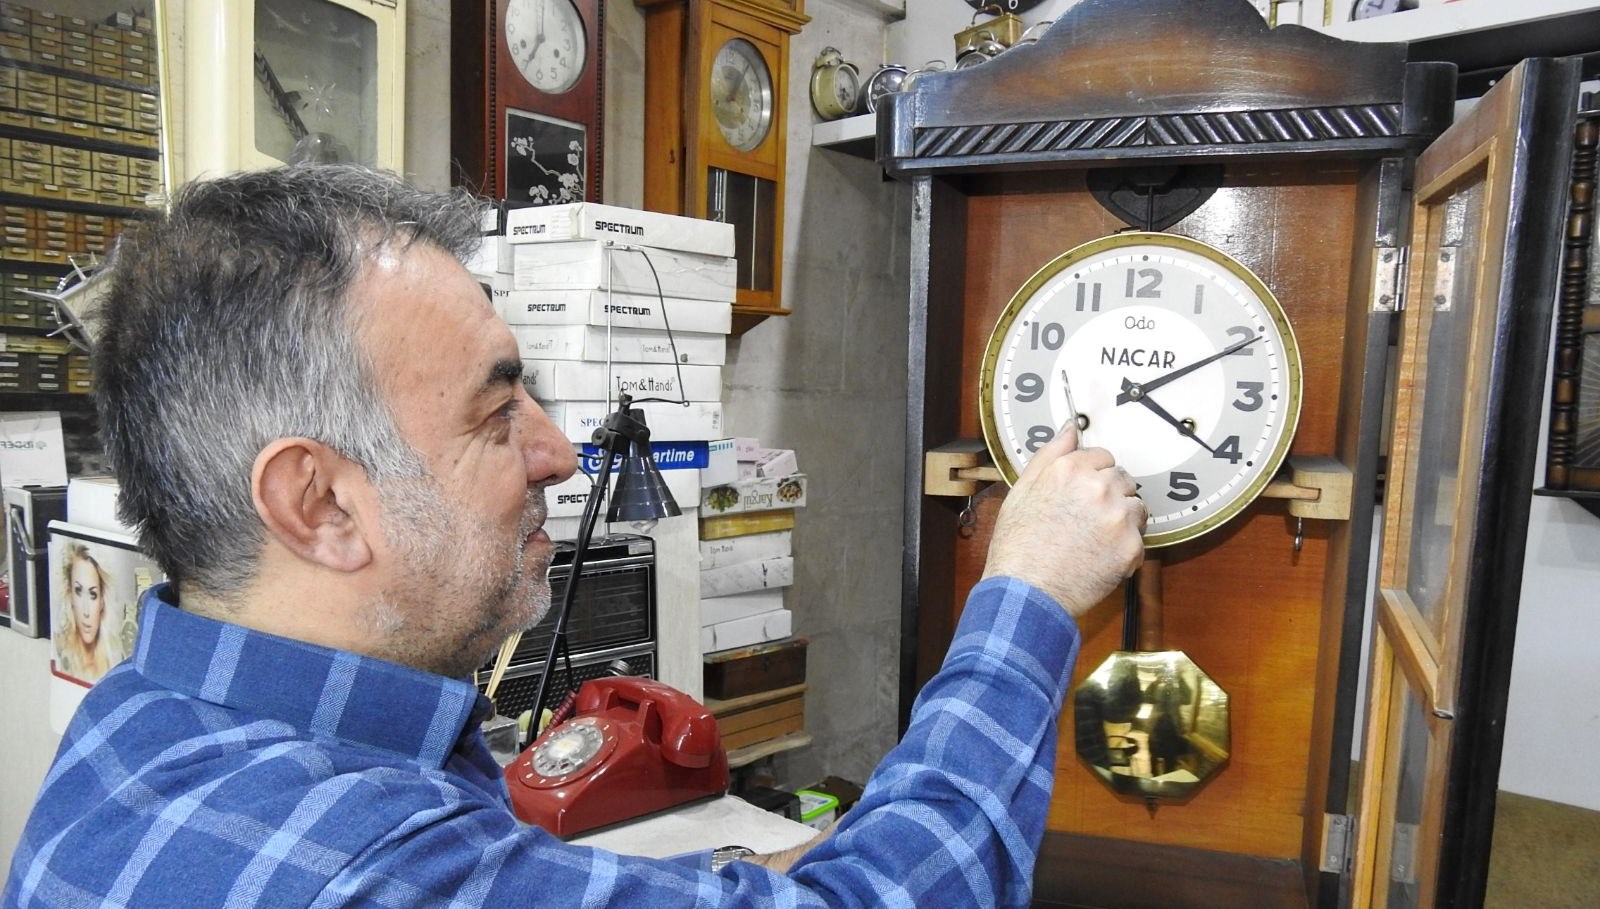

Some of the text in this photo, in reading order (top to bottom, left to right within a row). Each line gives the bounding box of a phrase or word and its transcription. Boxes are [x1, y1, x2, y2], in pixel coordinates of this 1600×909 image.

[513, 224, 546, 236] SPECTRUM
[594, 220, 645, 237] SPECTRUM
[1075, 282, 1102, 312] 11
[1124, 267, 1164, 298] 12
[527, 303, 566, 312] SPECTRUM
[604, 304, 651, 316] SPECTRUM
[1193, 284, 1205, 315] 1
[1030, 321, 1066, 351] 10
[1124, 315, 1155, 330] Odo
[1223, 325, 1255, 356] 2
[1100, 346, 1176, 369] NACAR
[1014, 372, 1045, 403] 9
[1232, 380, 1265, 412] 3
[580, 418, 603, 427] SPEC
[1025, 424, 1055, 454] 8
[1212, 435, 1243, 465] 4
[652, 449, 695, 463] artime
[557, 493, 605, 505] SPECT
[1166, 471, 1200, 501] 5
